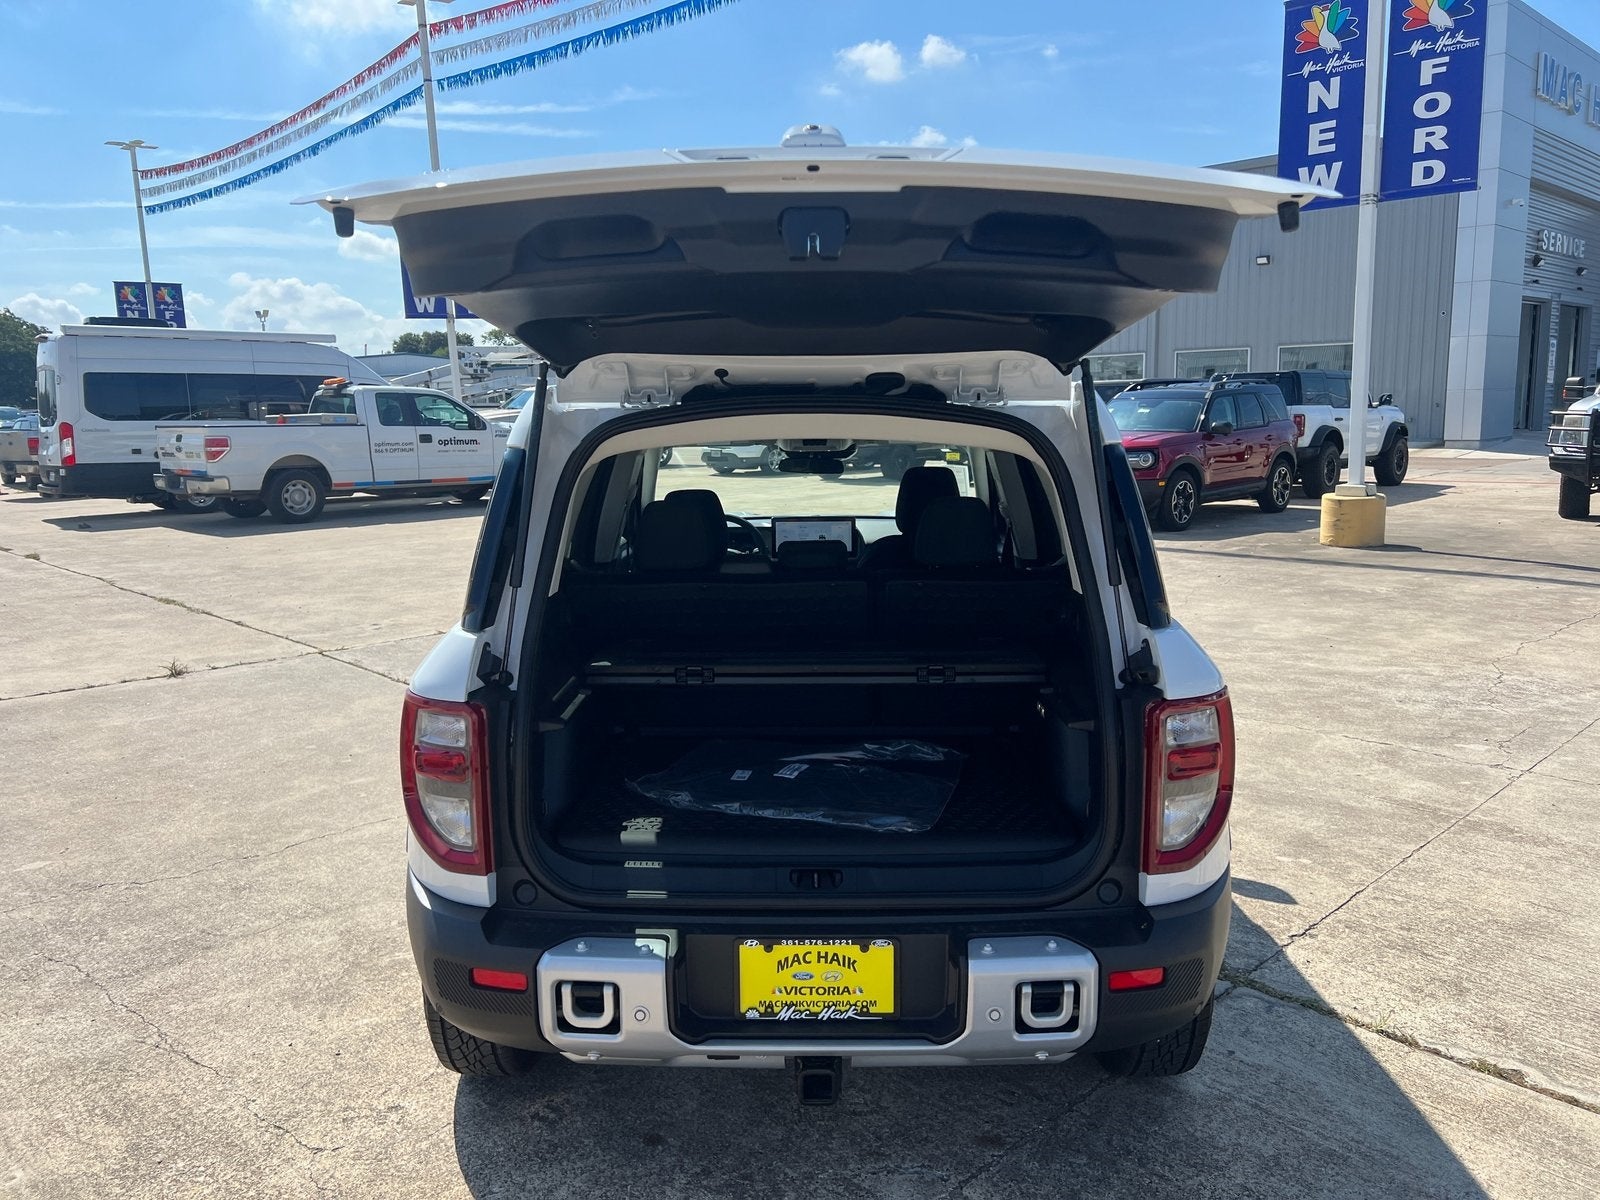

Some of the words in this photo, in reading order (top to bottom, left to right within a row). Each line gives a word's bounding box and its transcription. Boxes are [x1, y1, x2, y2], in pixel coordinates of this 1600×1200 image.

[1406, 39, 1435, 58] Mac
[1435, 30, 1474, 53] Haik
[1443, 41, 1480, 52] VICTORIA
[1298, 60, 1325, 79] Mac
[1325, 51, 1360, 74] Haik
[1332, 62, 1365, 73] VICTORIA
[1537, 51, 1583, 115] MAC
[1297, 76, 1343, 191] NEW
[1411, 56, 1451, 187] FORD
[1542, 229, 1586, 258] SERVICE
[776, 950, 812, 974] MAC
[816, 950, 858, 973] HAIK
[783, 986, 852, 996] VICTORIA
[774, 1005, 816, 1021] Mac
[817, 1005, 868, 1021] Haik
